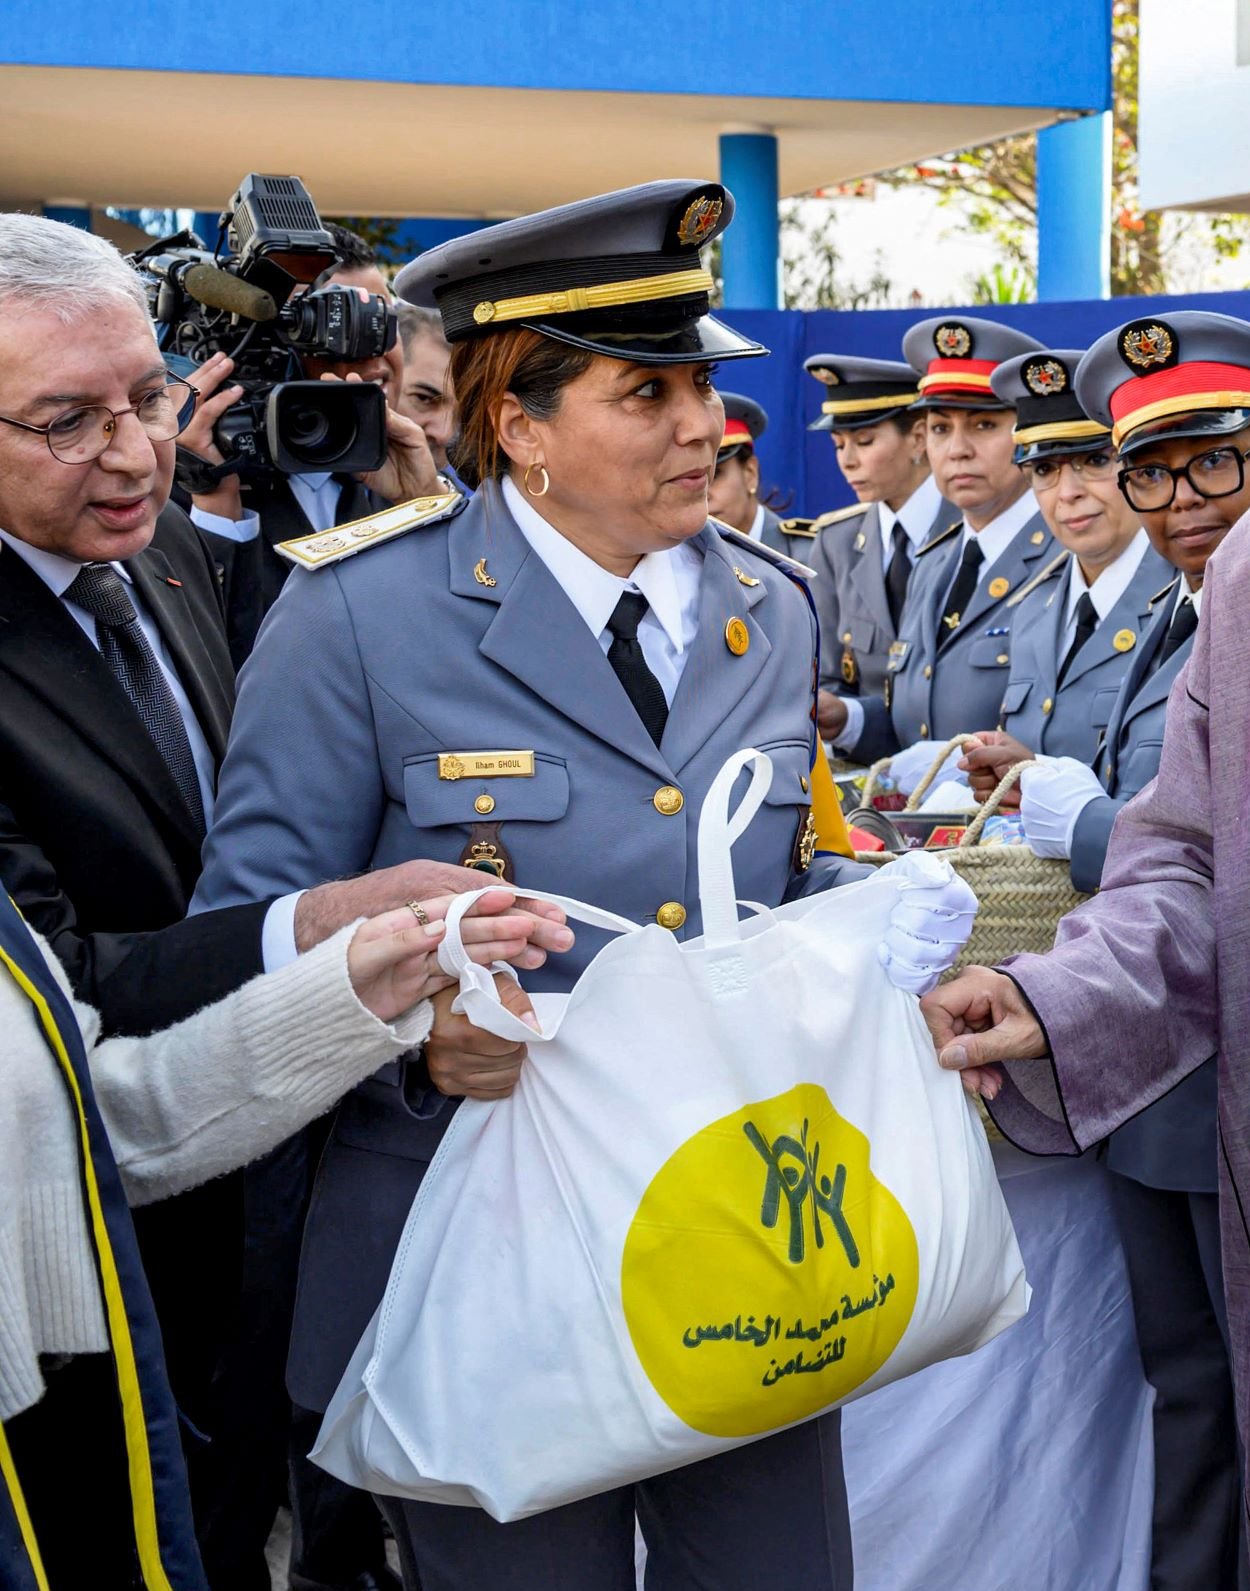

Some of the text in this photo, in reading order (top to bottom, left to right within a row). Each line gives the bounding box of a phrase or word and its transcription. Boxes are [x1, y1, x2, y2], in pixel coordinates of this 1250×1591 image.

[475, 760, 521, 769] Ilham GHOUL
[682, 1273, 895, 1349] مؤسسة محمد الخامس
[761, 1336, 847, 1387] للتضامن
